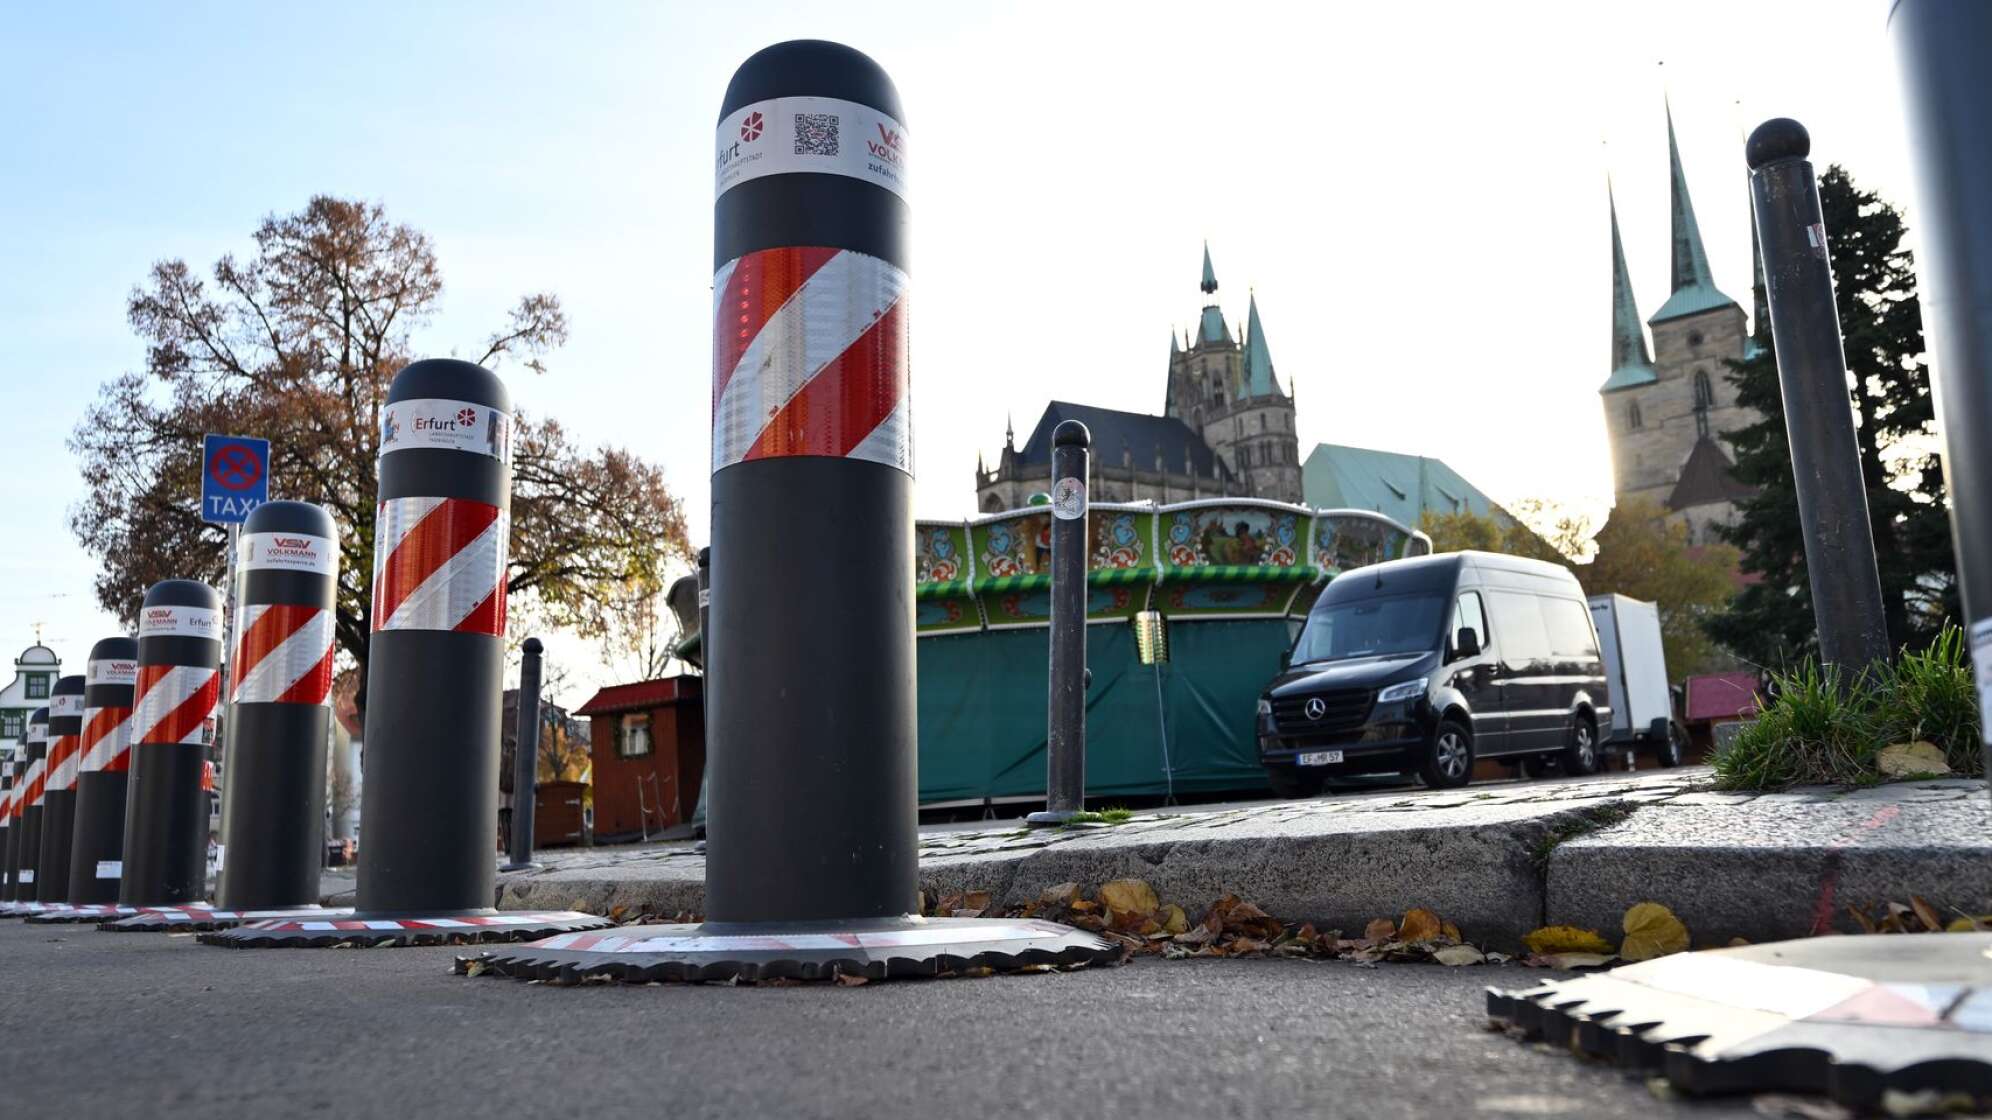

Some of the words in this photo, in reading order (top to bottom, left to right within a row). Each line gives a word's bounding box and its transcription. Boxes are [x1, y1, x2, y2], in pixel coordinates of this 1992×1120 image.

[415, 418, 456, 431] Erfurt
[274, 537, 311, 549] VSV
[267, 548, 317, 560] VOLKMANN
[190, 616, 212, 628] Erfurt
